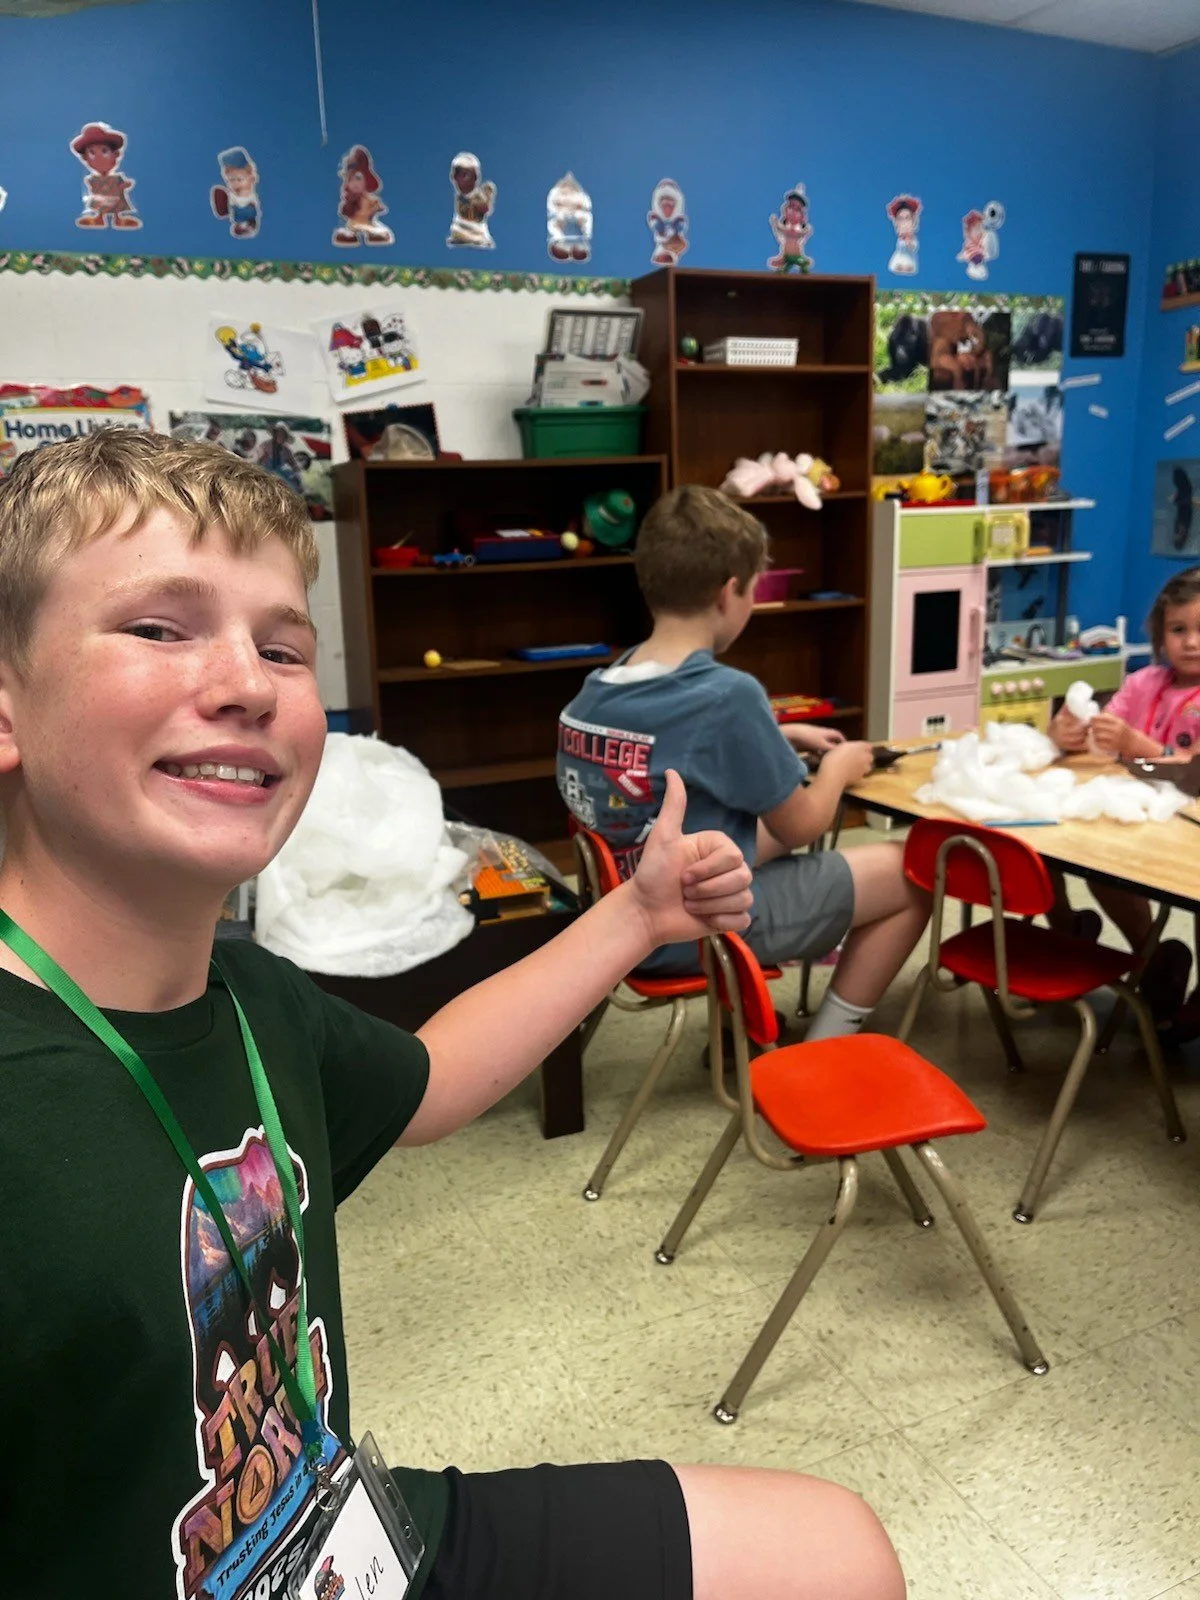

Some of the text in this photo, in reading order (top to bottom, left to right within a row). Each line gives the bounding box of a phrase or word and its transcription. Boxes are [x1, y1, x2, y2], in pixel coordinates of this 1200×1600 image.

[4, 419, 72, 438] Home
[563, 727, 651, 771] COLLEGE
[216, 1518, 269, 1588] Trusting
[269, 1485, 295, 1527] Jesus
